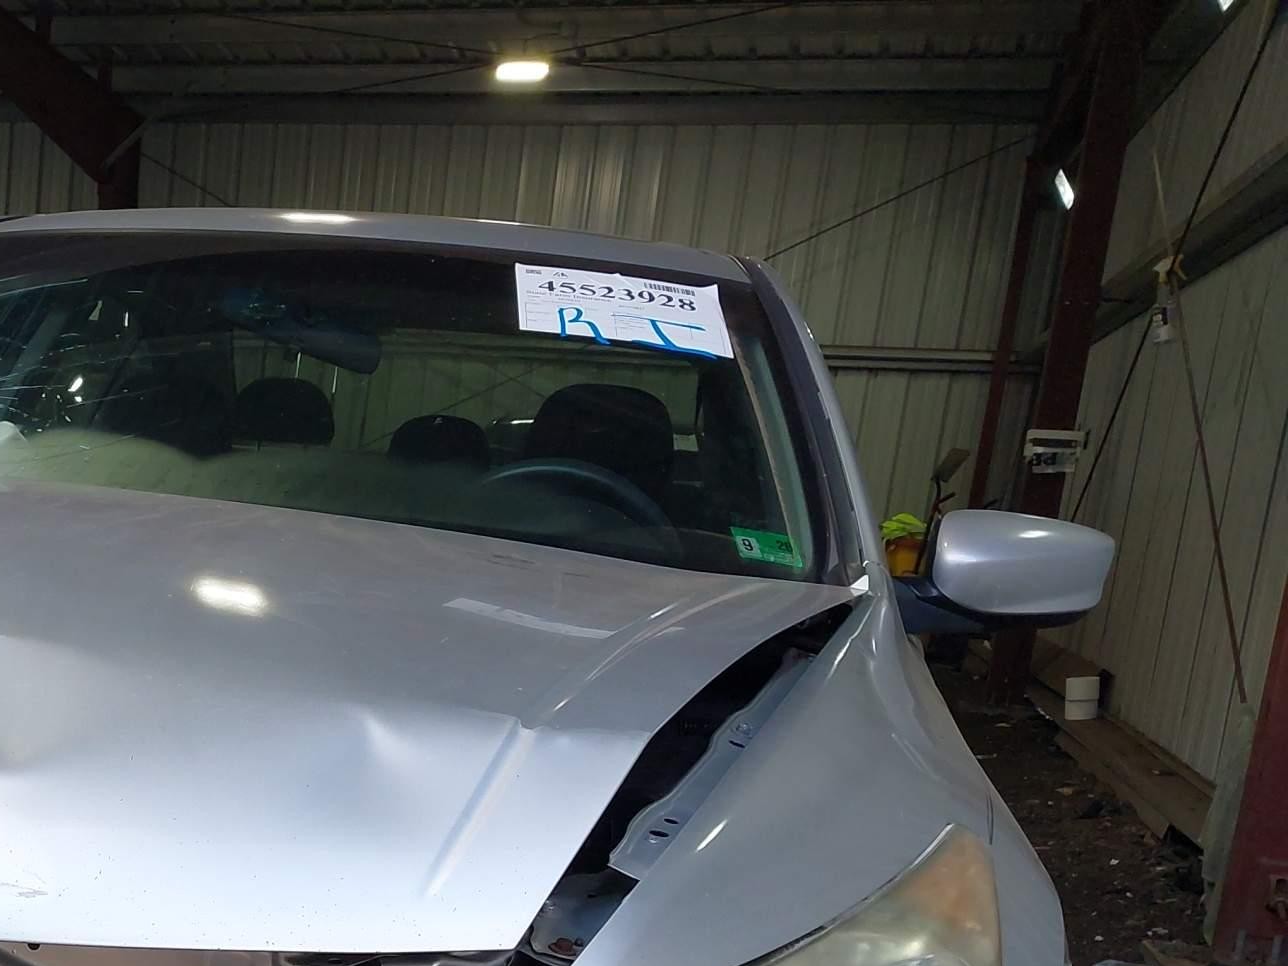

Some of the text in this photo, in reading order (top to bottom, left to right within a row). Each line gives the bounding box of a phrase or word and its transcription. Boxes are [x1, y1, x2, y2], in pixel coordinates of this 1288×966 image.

[538, 281, 697, 311] 45523928
[558, 307, 611, 345] R
[741, 538, 754, 551] 9
